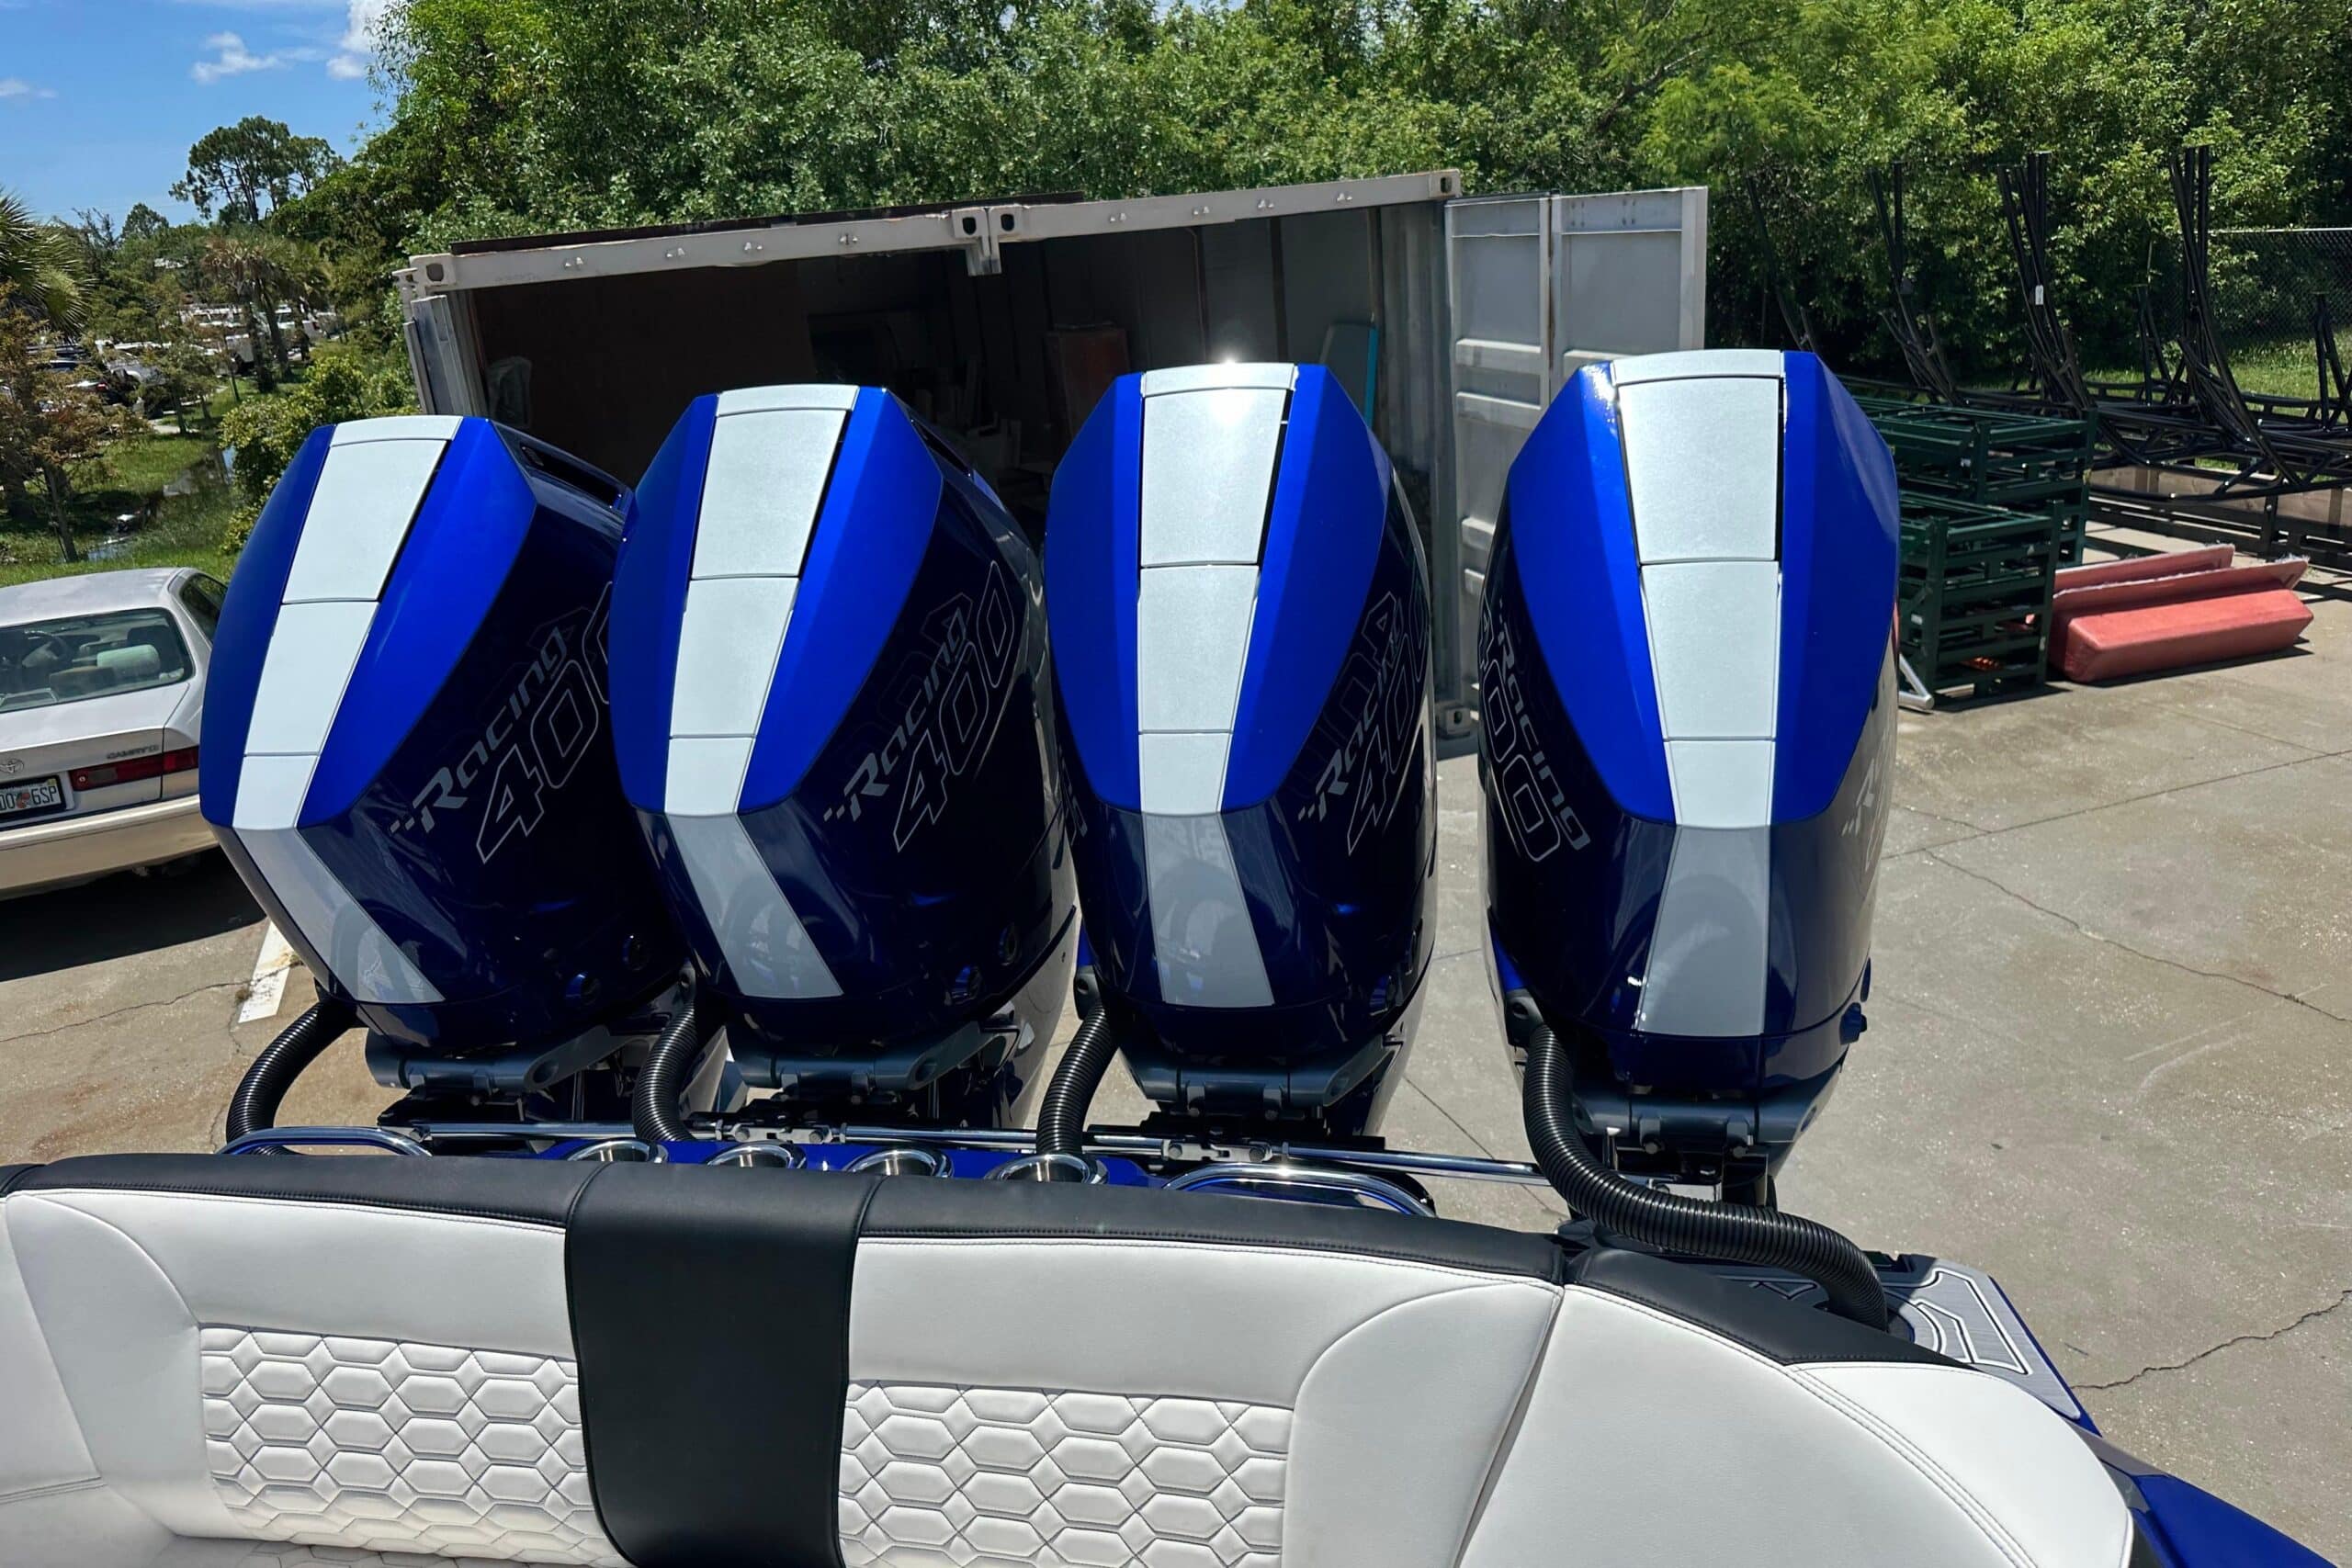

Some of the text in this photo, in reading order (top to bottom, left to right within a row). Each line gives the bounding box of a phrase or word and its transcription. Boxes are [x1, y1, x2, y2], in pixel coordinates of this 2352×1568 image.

[413, 626, 568, 834] Racing
[843, 607, 967, 822] Racing
[893, 559, 1014, 853] 400
[1498, 622, 1590, 851] Racing
